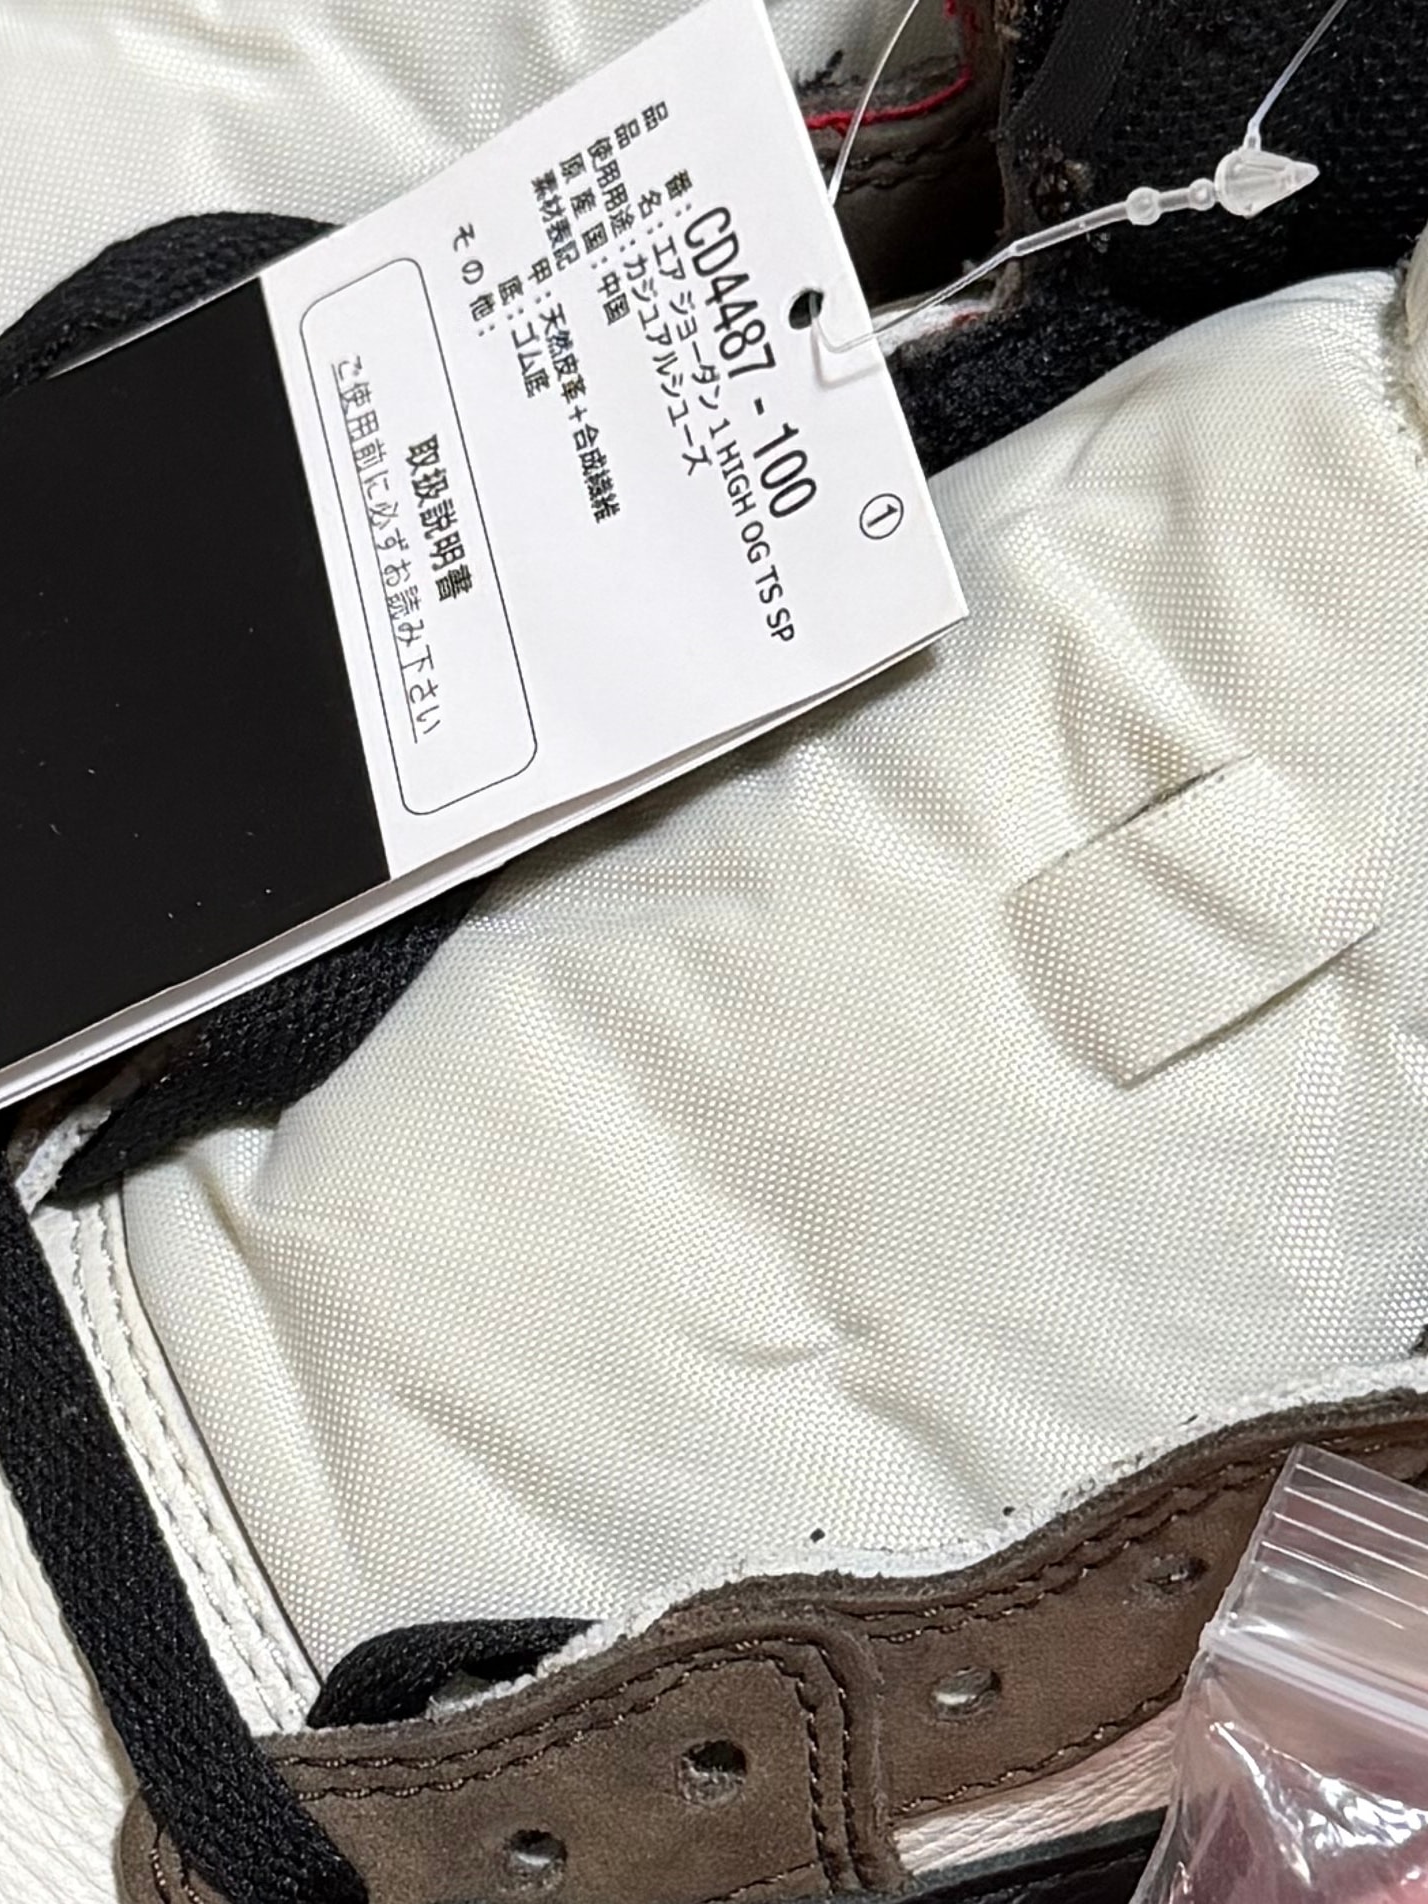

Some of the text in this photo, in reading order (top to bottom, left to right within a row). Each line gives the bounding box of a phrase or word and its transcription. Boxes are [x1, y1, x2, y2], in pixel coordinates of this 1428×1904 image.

[683, 205, 776, 379] CD4487
[751, 421, 817, 519] 100
[404, 433, 473, 602] 取扱説明書
[715, 438, 757, 518] HIGH
[332, 355, 441, 744] ご使用前に必ずお読み下さい
[740, 519, 771, 564] OG
[754, 563, 783, 604] TS
[765, 606, 795, 642] SP
